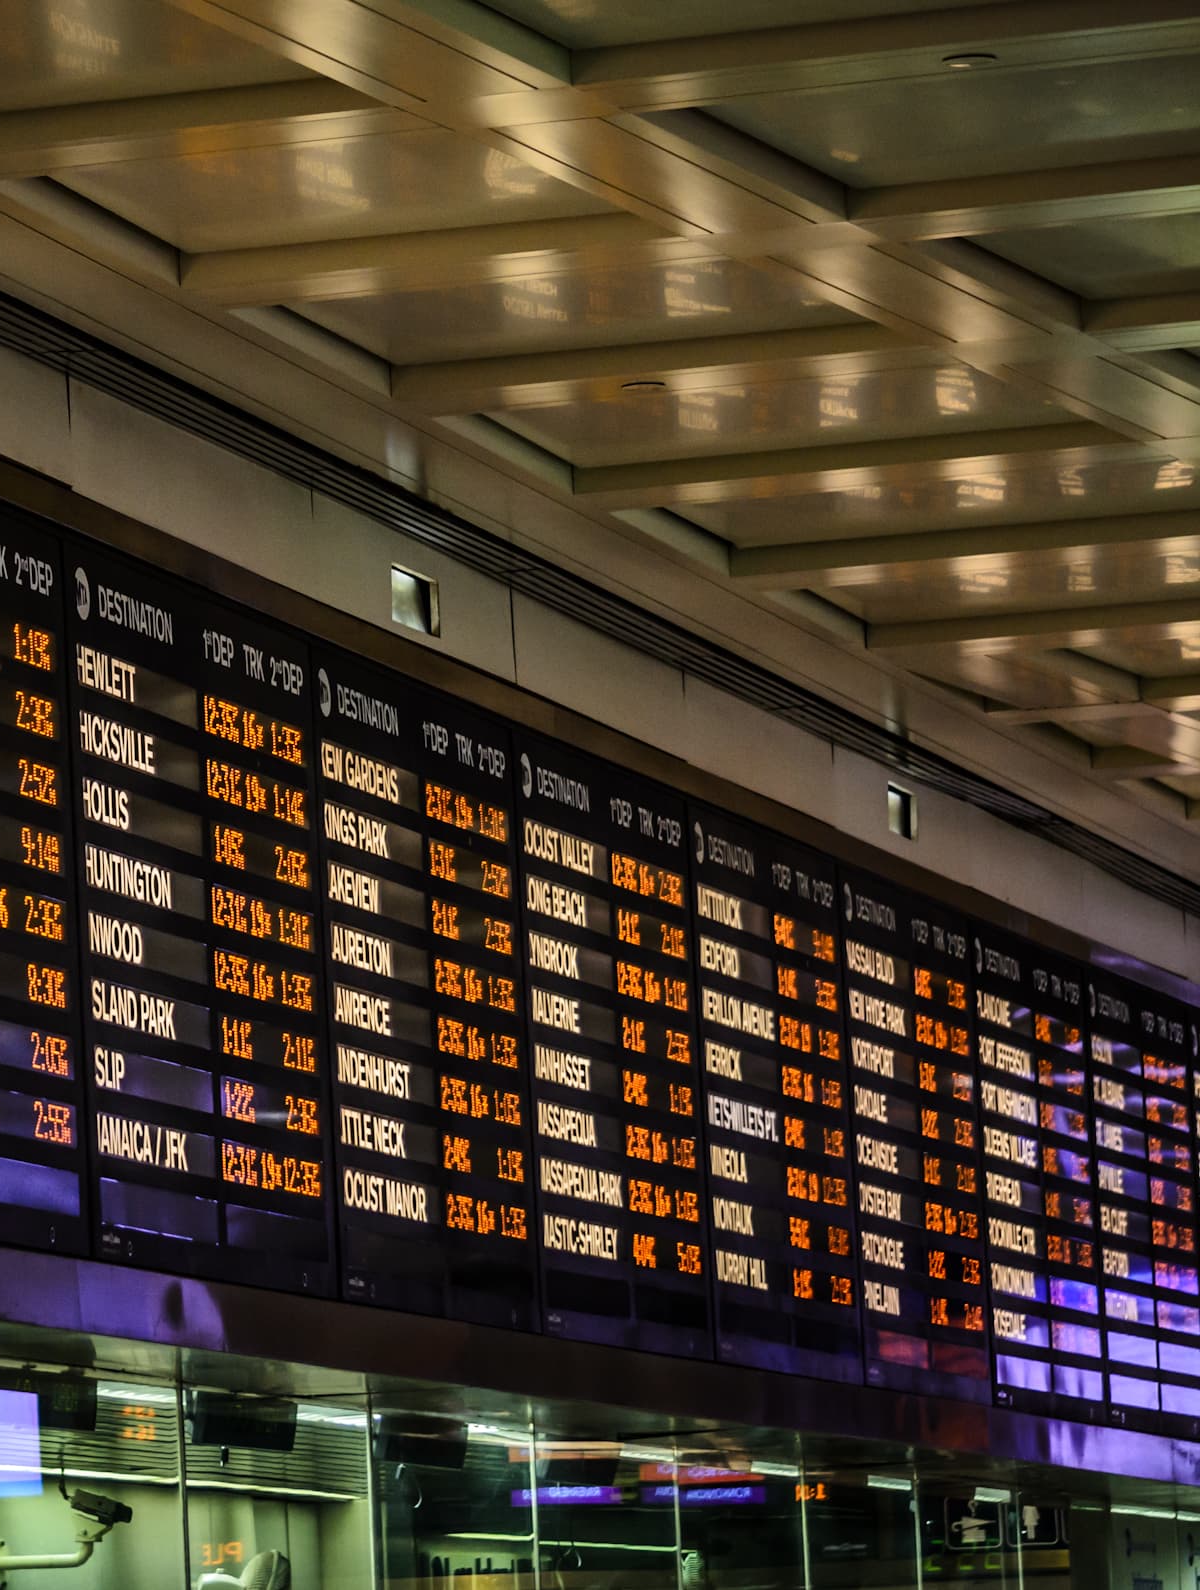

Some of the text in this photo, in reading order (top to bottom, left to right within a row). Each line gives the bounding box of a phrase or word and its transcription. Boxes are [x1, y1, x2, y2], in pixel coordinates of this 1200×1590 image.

[98, 584, 265, 682] DESTINATION TRK
[77, 643, 136, 703] HEWLETT
[337, 684, 399, 737] DESTINATION
[80, 710, 156, 775] HICKSVILLE
[82, 776, 130, 831] HOLLIS
[345, 751, 400, 805] GARDENS
[537, 766, 590, 813] DESTINATION
[358, 813, 389, 859] PARK
[524, 821, 594, 877] OCUST VALLEY
[85, 844, 172, 909] HUNTINGTON
[552, 887, 586, 928] BEACH
[529, 932, 580, 980] YNBROOK
[140, 994, 177, 1041] PARK
[337, 1045, 410, 1100] INDENHURST
[164, 1127, 188, 1173] JFK
[373, 1115, 406, 1159] NECK
[386, 1179, 428, 1223] MANOR
